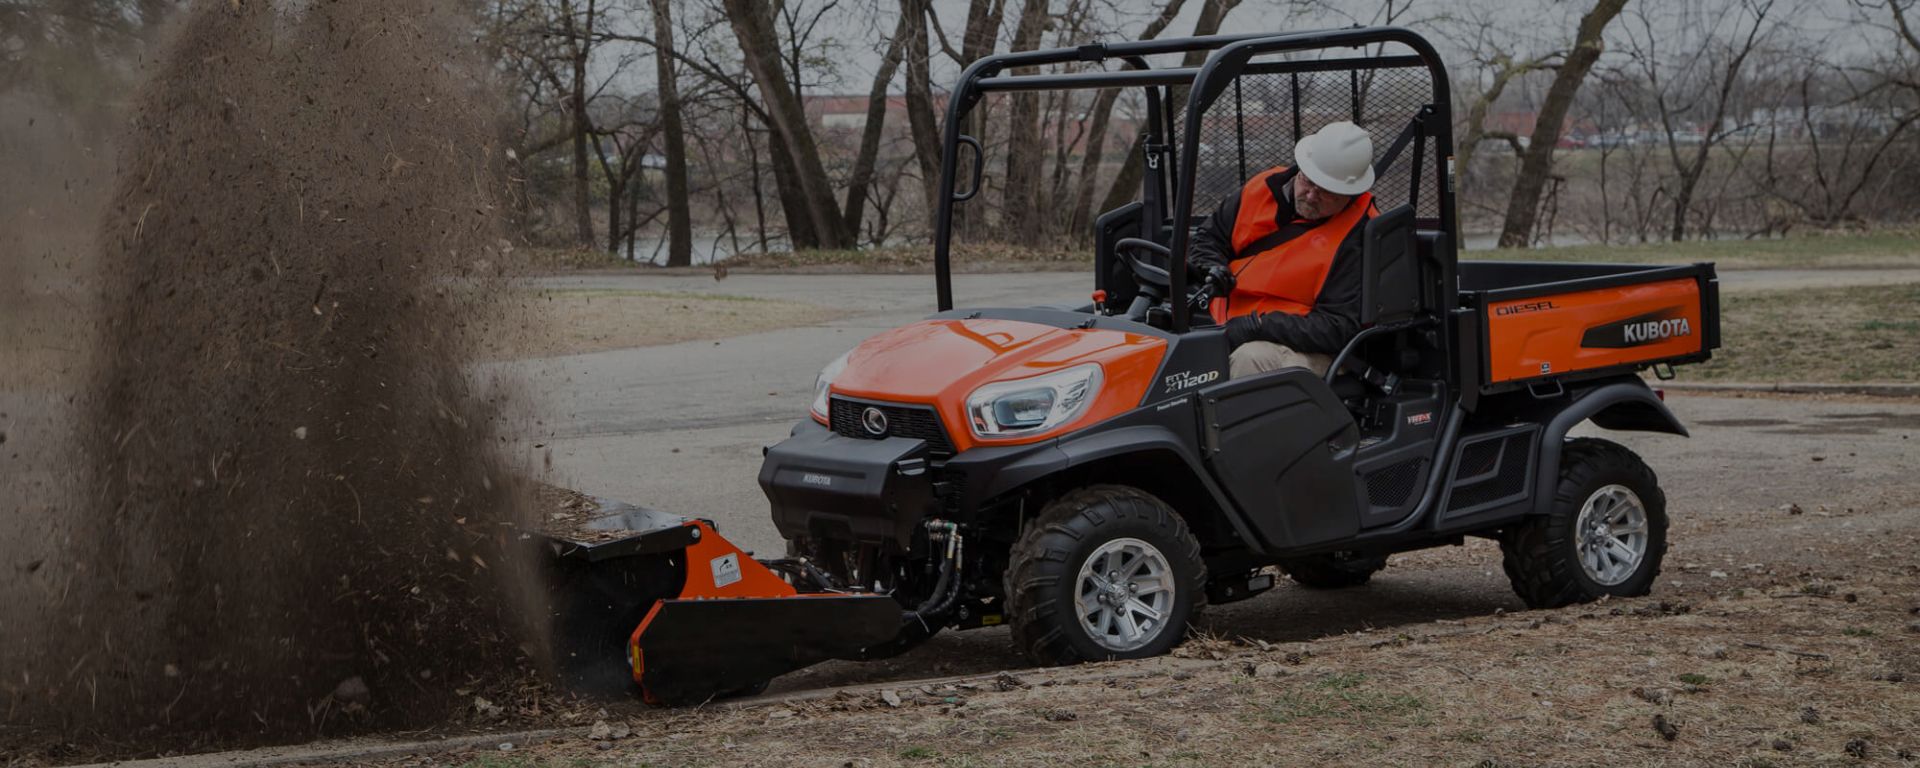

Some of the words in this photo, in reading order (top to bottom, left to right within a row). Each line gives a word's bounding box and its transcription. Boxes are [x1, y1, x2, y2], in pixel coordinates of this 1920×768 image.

[1496, 301, 1560, 316] DIESEL
[1624, 318, 1690, 342] KUBOTA
[1165, 370, 1191, 384] RTV
